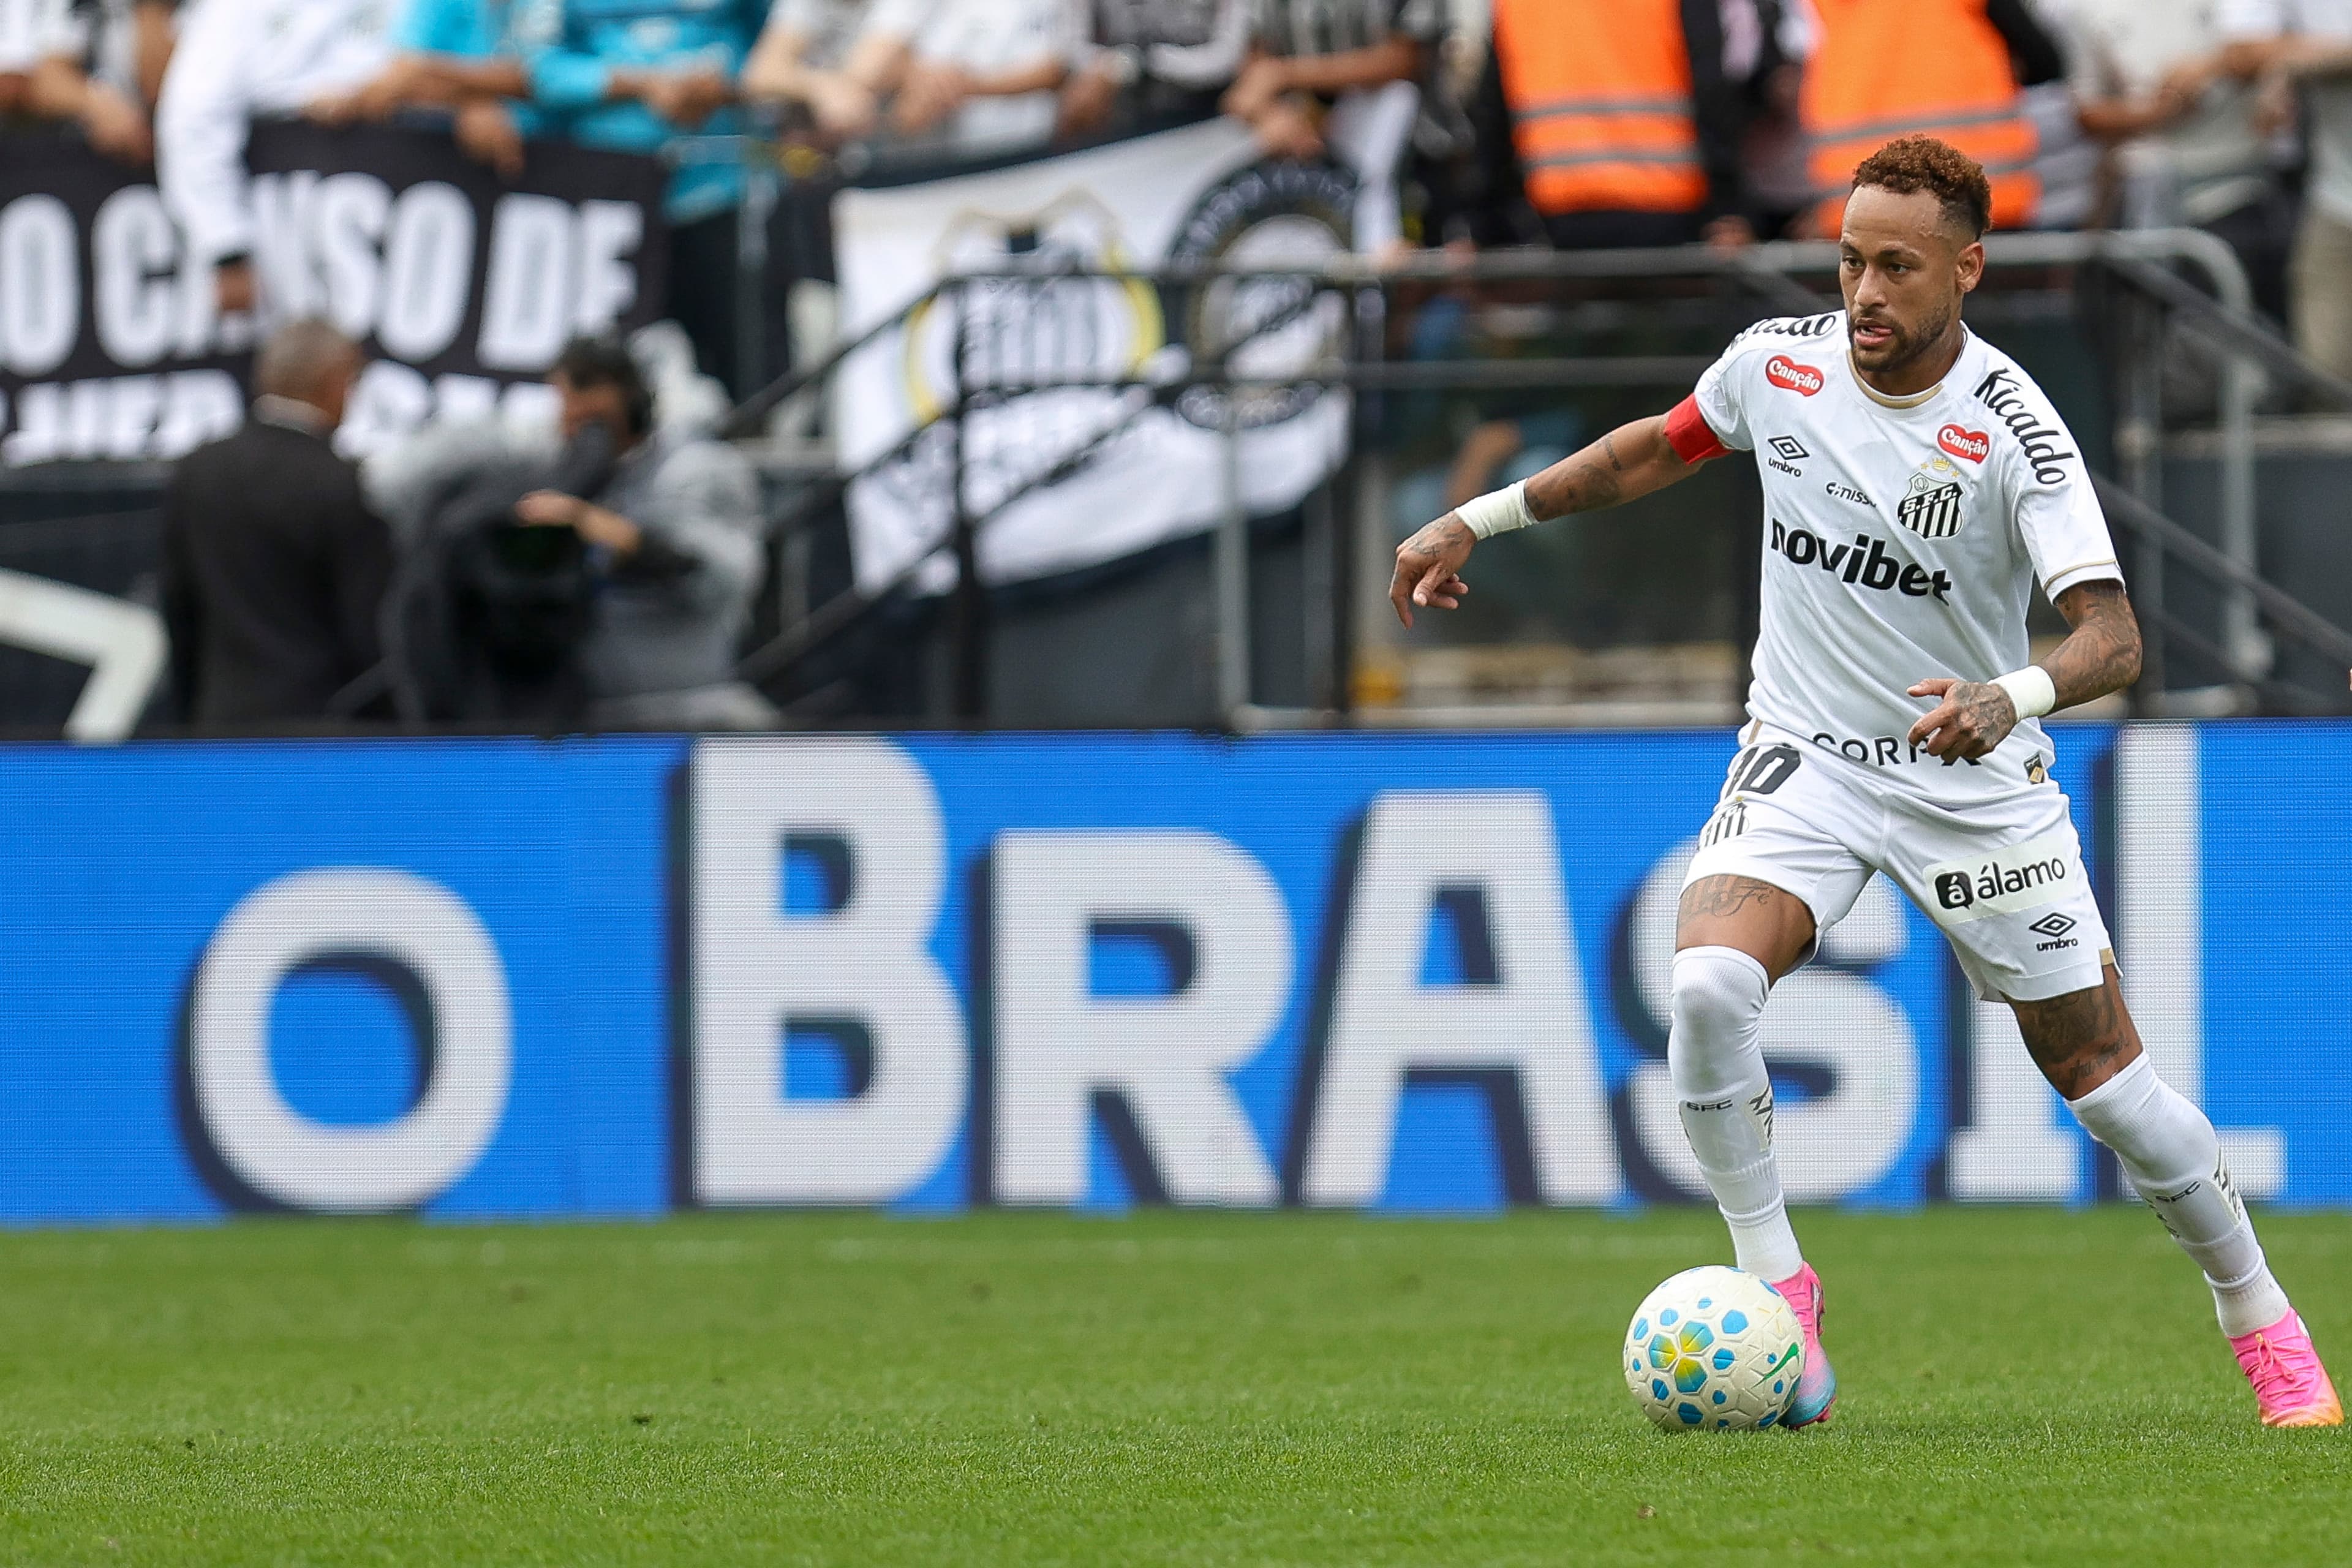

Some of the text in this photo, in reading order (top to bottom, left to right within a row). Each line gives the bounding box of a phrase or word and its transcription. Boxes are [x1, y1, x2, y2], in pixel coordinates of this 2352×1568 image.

[1769, 360, 1821, 390] Canção
[1941, 428, 1988, 456] Canção
[1973, 367, 2075, 484] Kicaldo
[1768, 456, 1802, 477] umbro
[1771, 517, 1952, 607] novibet
[1725, 745, 1802, 799] 10
[1977, 857, 2065, 899] álamo
[2036, 937, 2078, 952] umbro
[189, 865, 513, 1212] O
